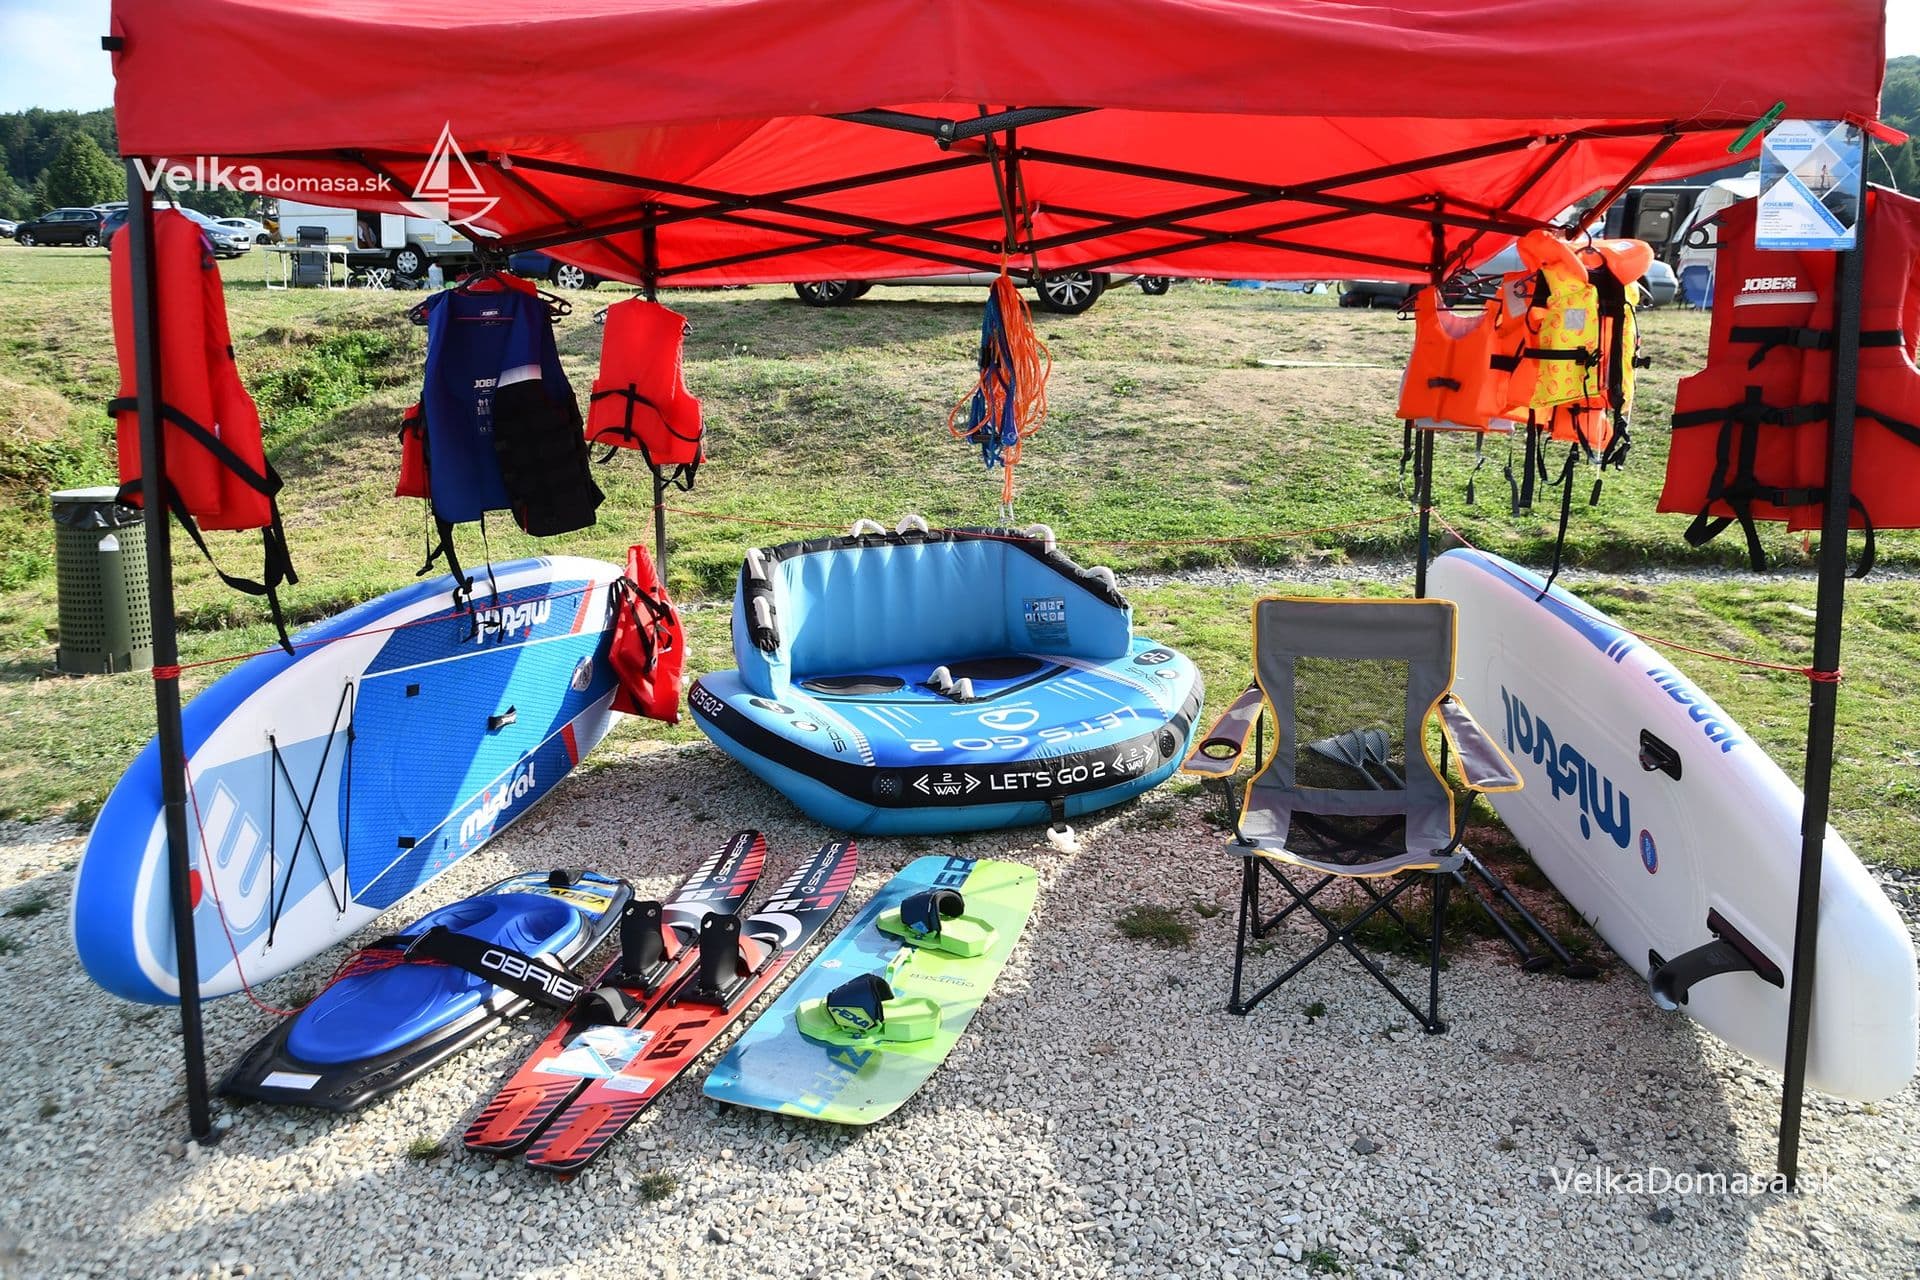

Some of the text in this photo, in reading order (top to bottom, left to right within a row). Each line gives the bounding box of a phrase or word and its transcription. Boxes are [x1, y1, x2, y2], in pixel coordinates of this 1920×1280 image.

[1742, 277, 1783, 291] JOBE
[1037, 705, 1140, 744] LET'S
[904, 738, 945, 752] 2
[952, 734, 1030, 751] GO
[1130, 748, 1138, 757] 2
[1126, 760, 1144, 773] WAY
[1501, 685, 1631, 849] mistral
[943, 772, 953, 782] 2
[990, 761, 1106, 791] LET'S GO 2
[933, 784, 962, 796] WAY
[459, 761, 536, 846] mistral
[718, 833, 750, 876] SPINERA
[808, 843, 842, 886] SPINERA
